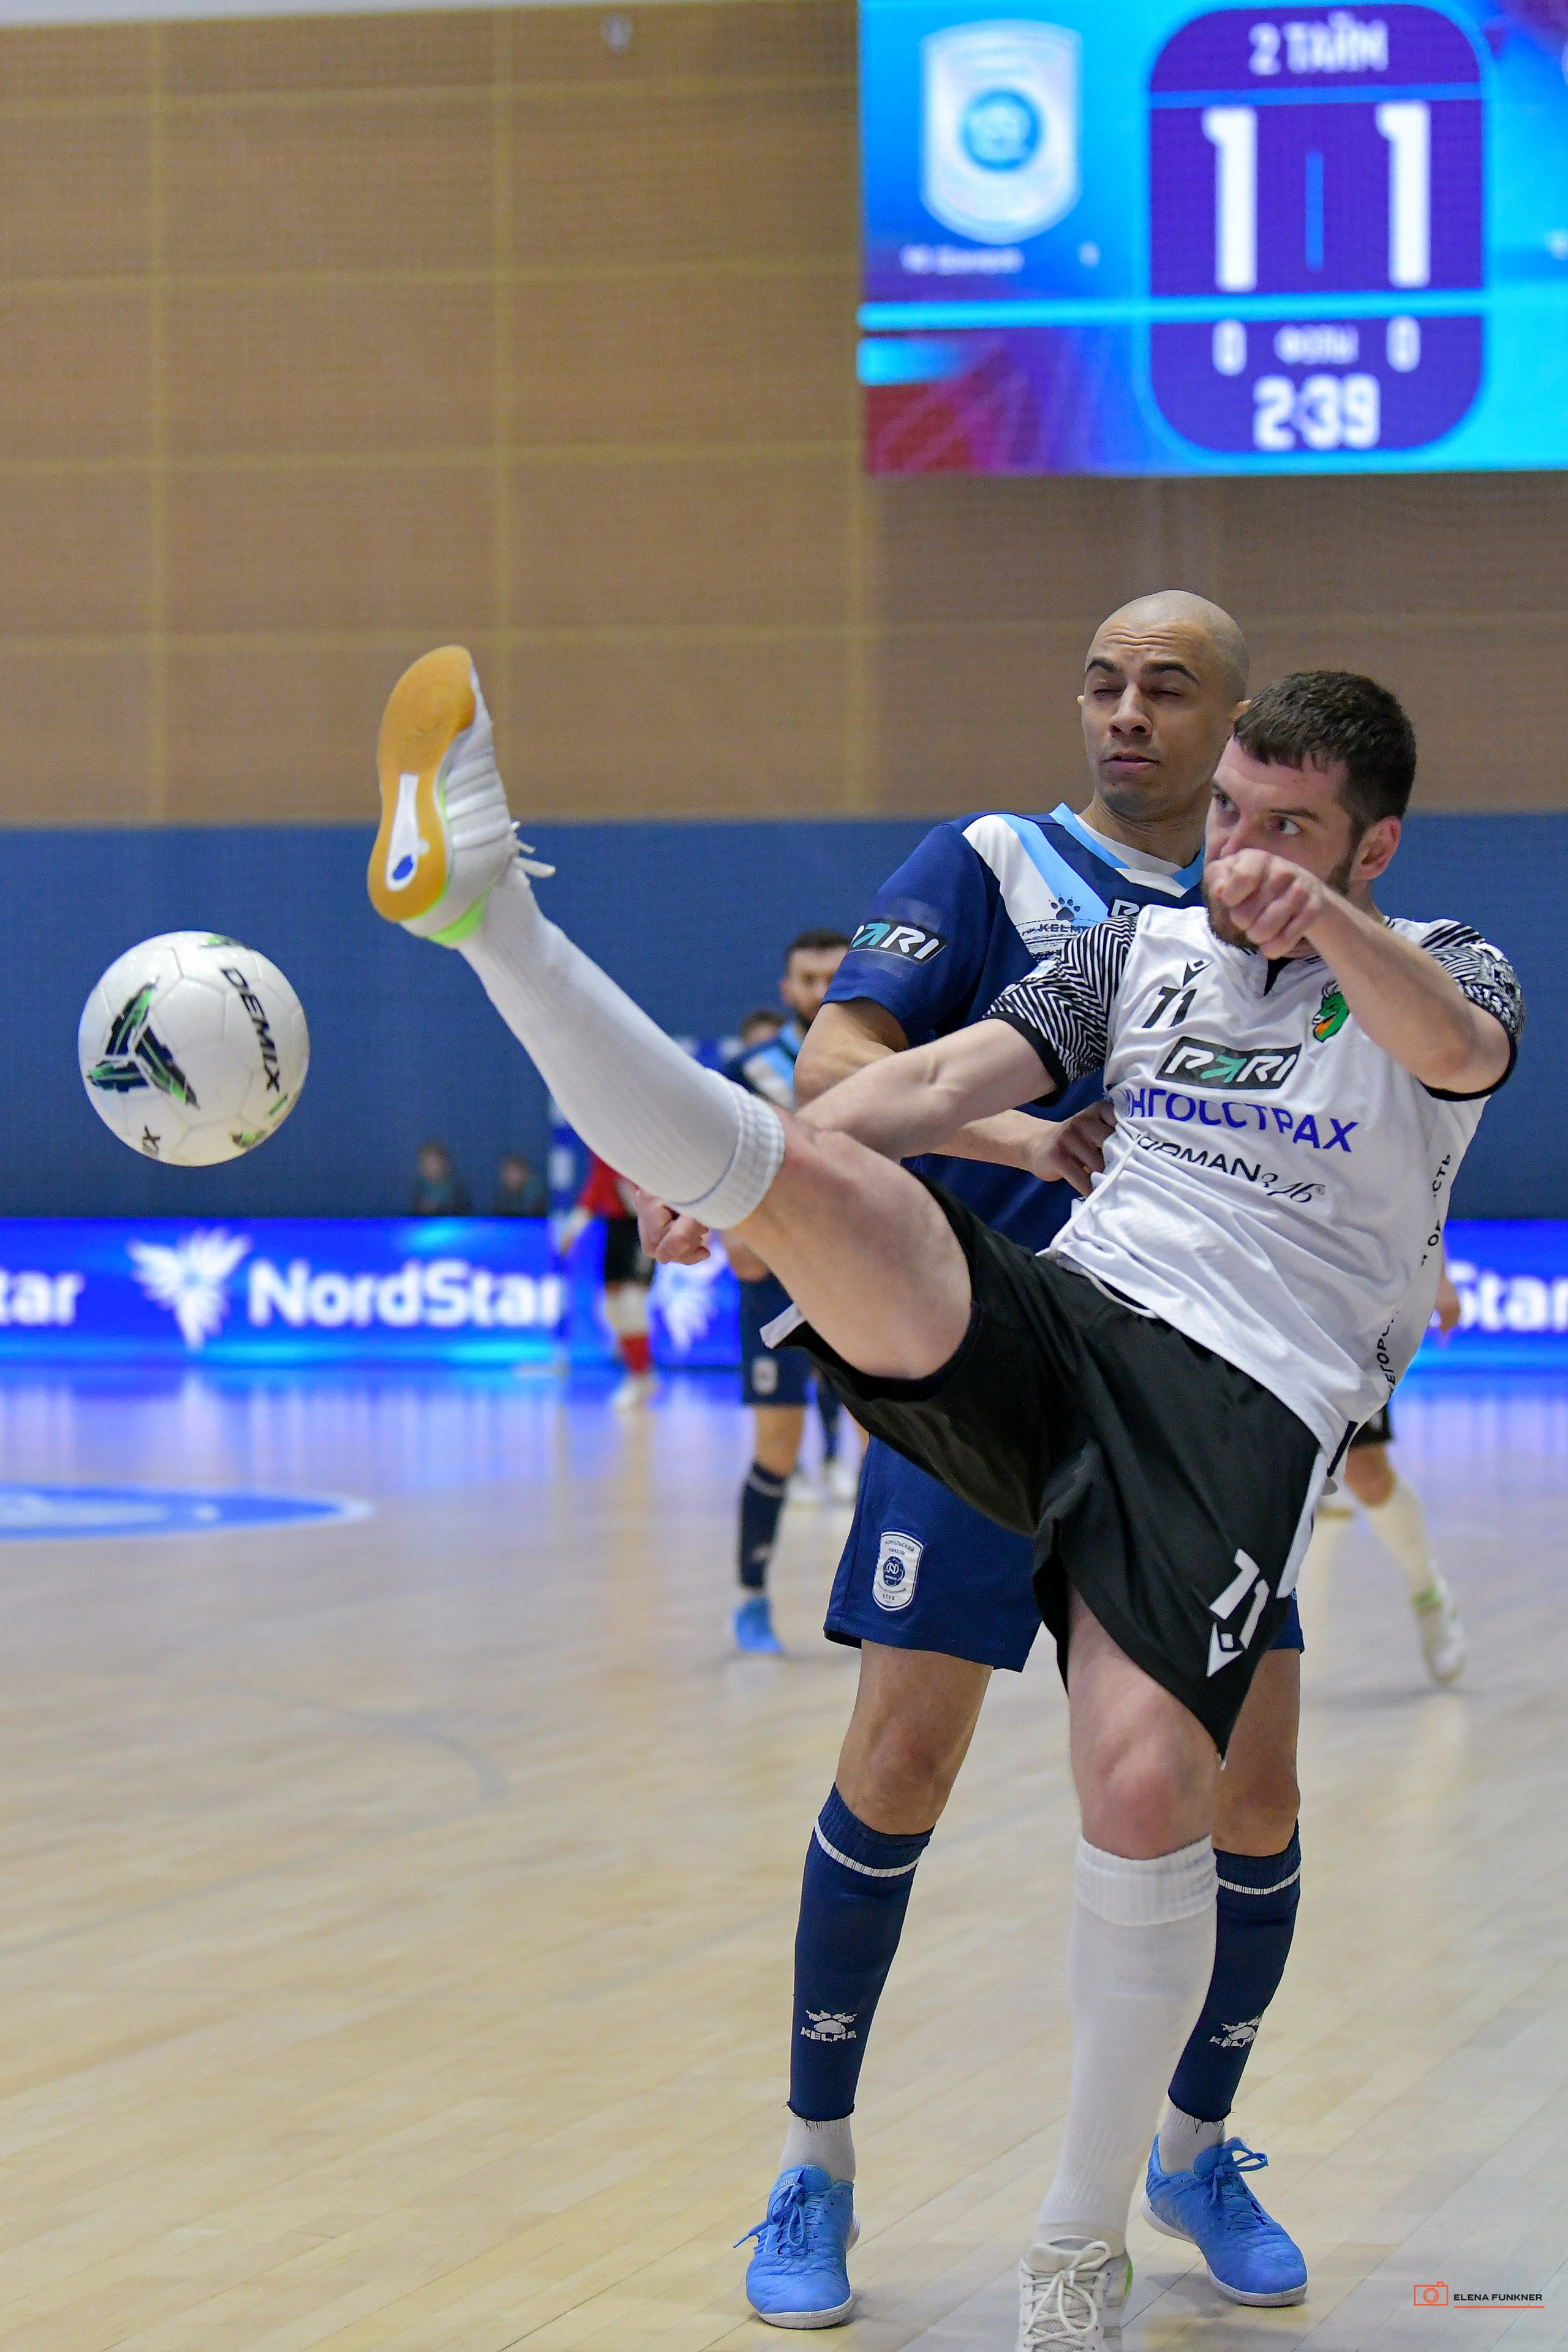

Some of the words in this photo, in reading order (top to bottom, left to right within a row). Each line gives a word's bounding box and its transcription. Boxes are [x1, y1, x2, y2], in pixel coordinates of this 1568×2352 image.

[1250, 22, 1281, 76] 2
[1204, 105, 1257, 292] 1
[1376, 100, 1431, 288] 1
[1165, 1046, 1297, 1083] PARI
[1120, 1088, 1359, 1153] НГОССТРАХ
[247, 1258, 562, 1328] NordStar
